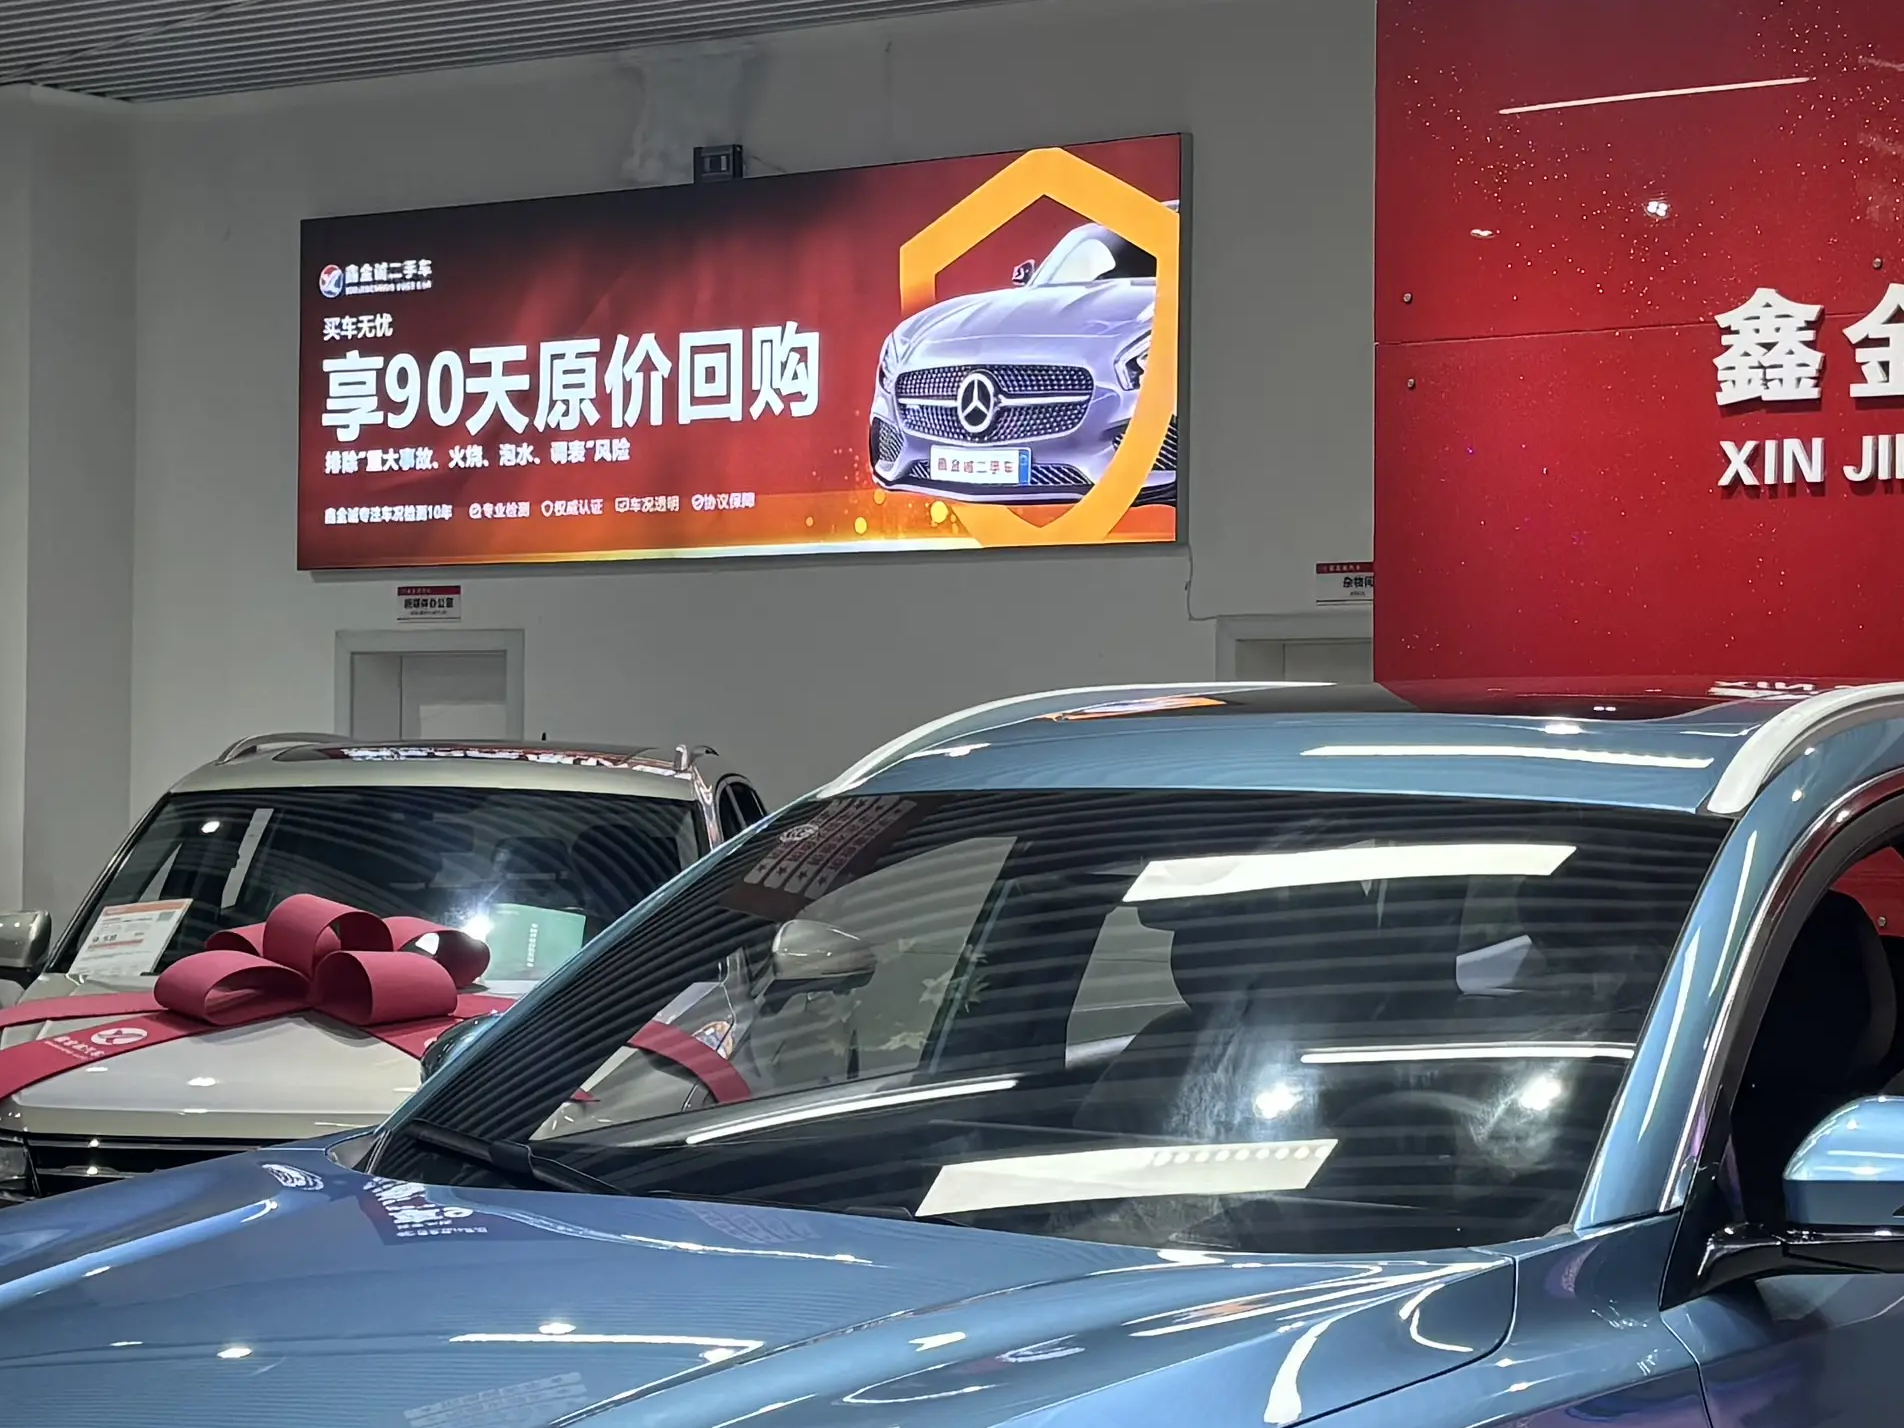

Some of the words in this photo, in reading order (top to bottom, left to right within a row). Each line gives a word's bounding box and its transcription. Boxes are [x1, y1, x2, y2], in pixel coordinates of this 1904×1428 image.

[322, 313, 394, 342] 买车无忧
[322, 320, 821, 442] 享90天原价回购
[1717, 438, 1825, 486] XIN
